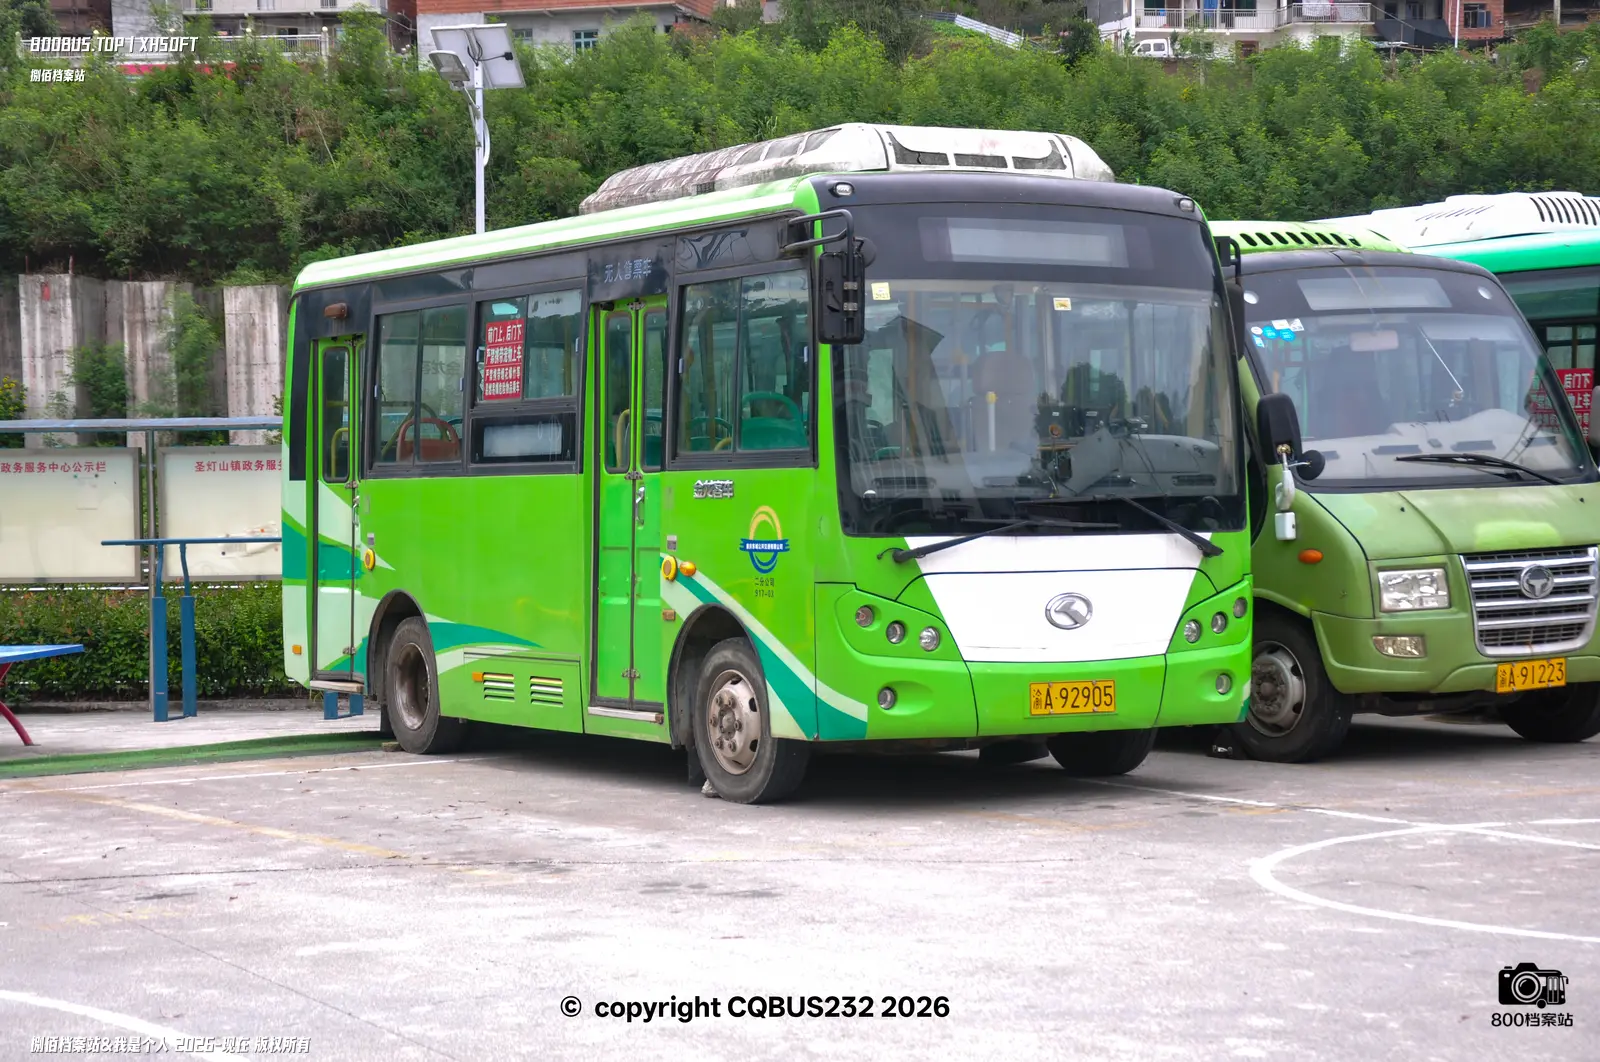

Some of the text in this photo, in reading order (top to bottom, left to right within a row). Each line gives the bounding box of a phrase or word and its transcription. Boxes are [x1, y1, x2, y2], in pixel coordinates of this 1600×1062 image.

[0, 461, 107, 474] 政务服务中心公示栏
